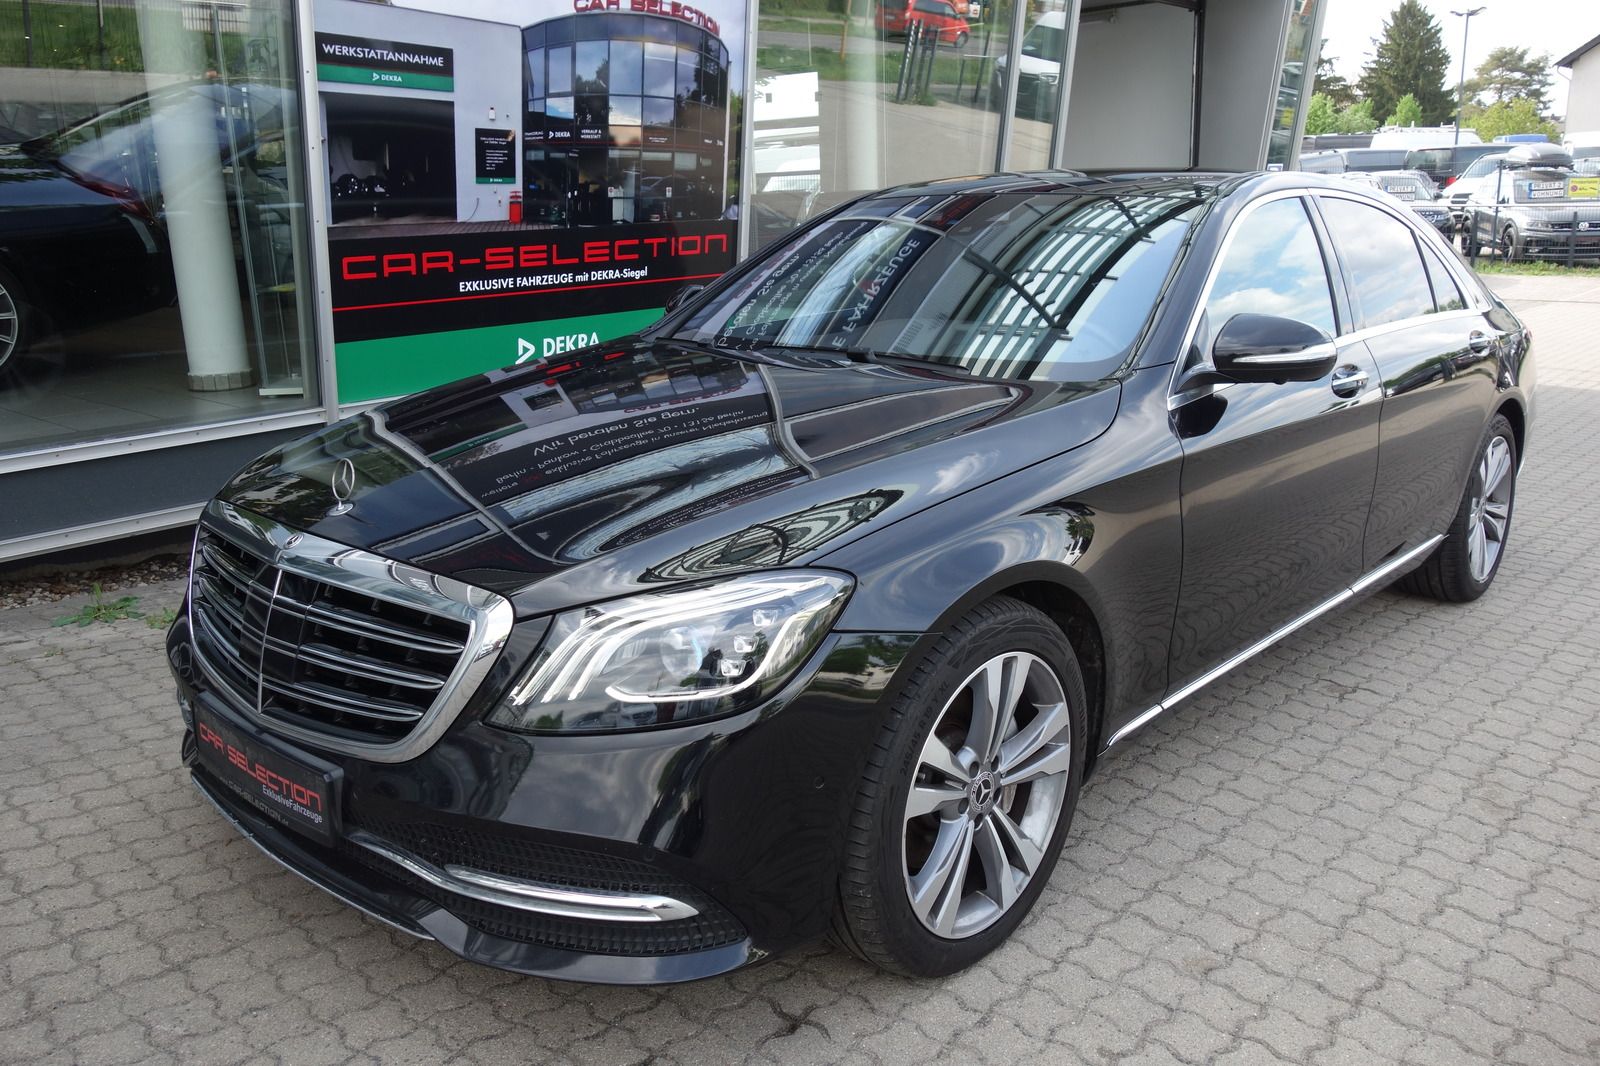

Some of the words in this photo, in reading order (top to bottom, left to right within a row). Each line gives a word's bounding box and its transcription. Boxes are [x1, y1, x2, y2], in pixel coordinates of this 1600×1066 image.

[322, 43, 444, 67] WERKSTATTANNAHME
[381, 74, 402, 82] DEKRA
[342, 233, 729, 281] CAR-SELECTION
[459, 278, 514, 292] EXKLUSIVE
[516, 273, 573, 288] FAHRZEUGE
[575, 272, 589, 282] mit
[591, 266, 648, 282] DEKRA-Siegel
[543, 331, 599, 357] DEKRA
[200, 722, 224, 754] CAR
[227, 745, 322, 812] SELECTION
[262, 784, 323, 824] ExklusiveFahrzeuge
